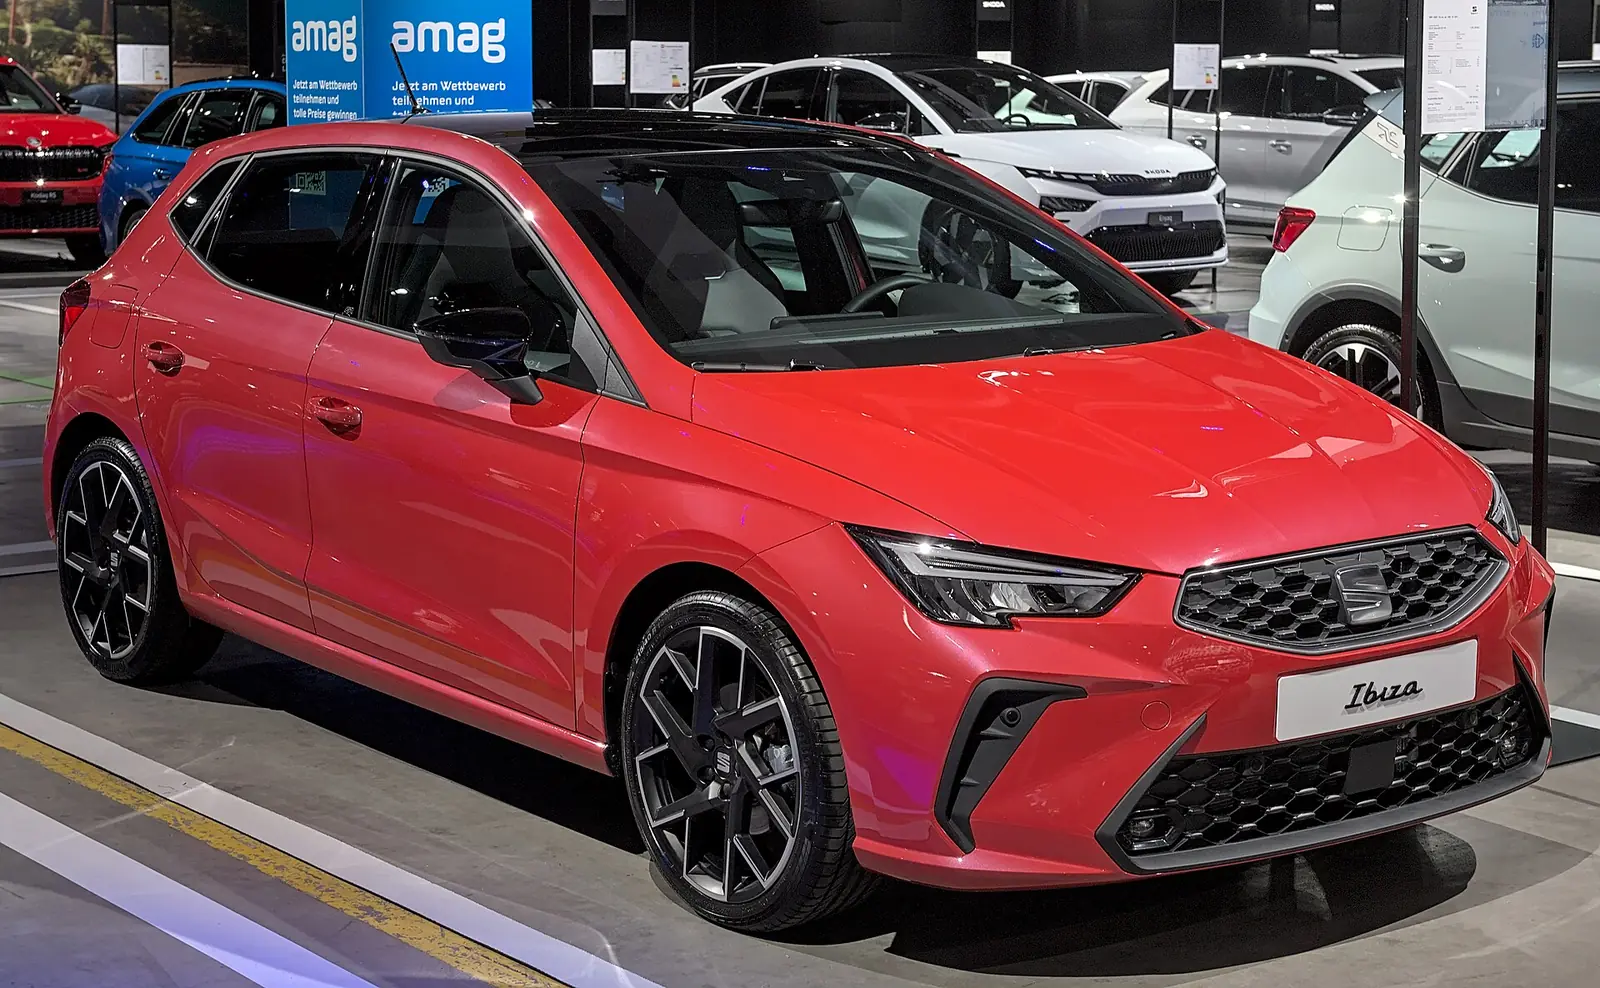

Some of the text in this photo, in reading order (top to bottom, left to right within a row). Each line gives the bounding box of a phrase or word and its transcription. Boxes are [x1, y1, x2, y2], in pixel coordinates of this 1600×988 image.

[292, 16, 357, 62] amag
[392, 18, 506, 63] amag
[293, 79, 358, 91] Jetzt am Wettbewerb
[392, 81, 506, 91] Jezt am Wettbewerb
[293, 94, 340, 105] teilnehmen und
[392, 96, 475, 106] teilehmen und
[293, 108, 358, 121] tolle Preise gewinnen
[1344, 680, 1424, 710] Ibiza
